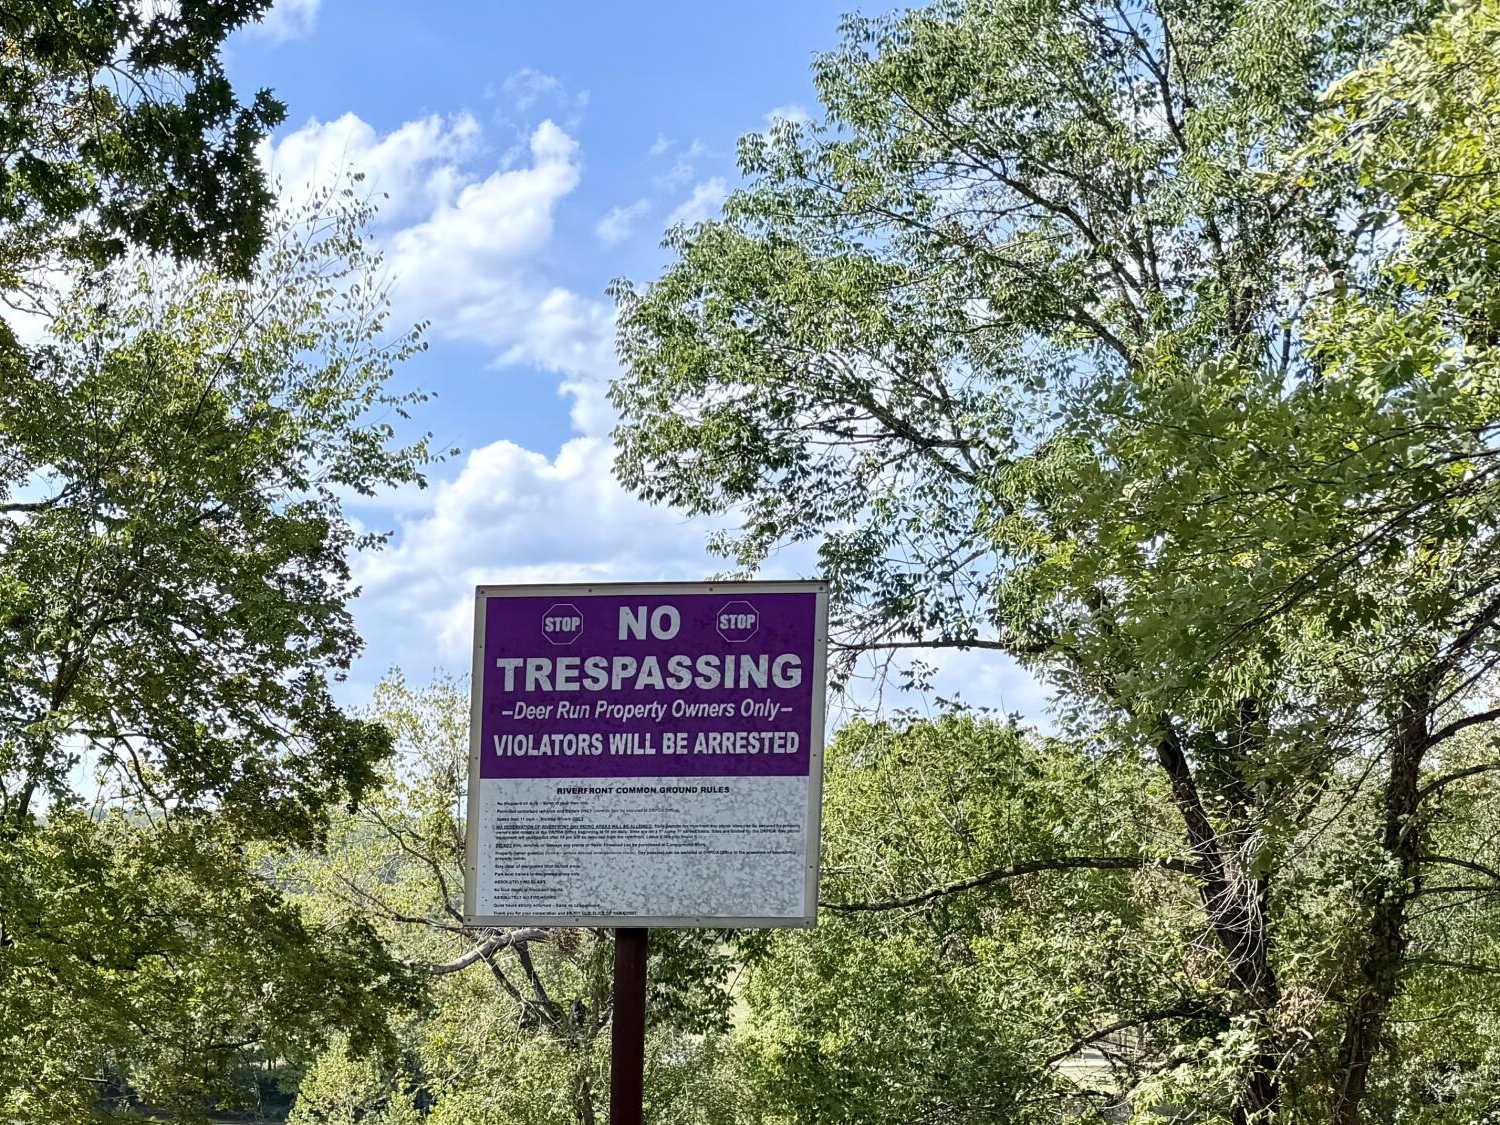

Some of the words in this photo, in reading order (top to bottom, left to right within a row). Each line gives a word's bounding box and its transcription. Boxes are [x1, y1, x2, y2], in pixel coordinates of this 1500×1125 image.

[545, 616, 581, 633] STOP
[618, 604, 681, 641] NO
[719, 614, 756, 630] STOP
[496, 653, 802, 692] TRESPASSING
[556, 701, 590, 719] Run
[595, 700, 667, 723] Property
[671, 699, 735, 718] Owners
[493, 733, 603, 757] VIOLATORS
[609, 732, 655, 756] WILL
[662, 732, 689, 755] BE
[693, 731, 800, 755] ARRESTED
[556, 787, 614, 795] RIVERFRONT
[615, 786, 657, 795] COMMON
[659, 786, 698, 794] GROUND
[700, 785, 731, 794] RULES
